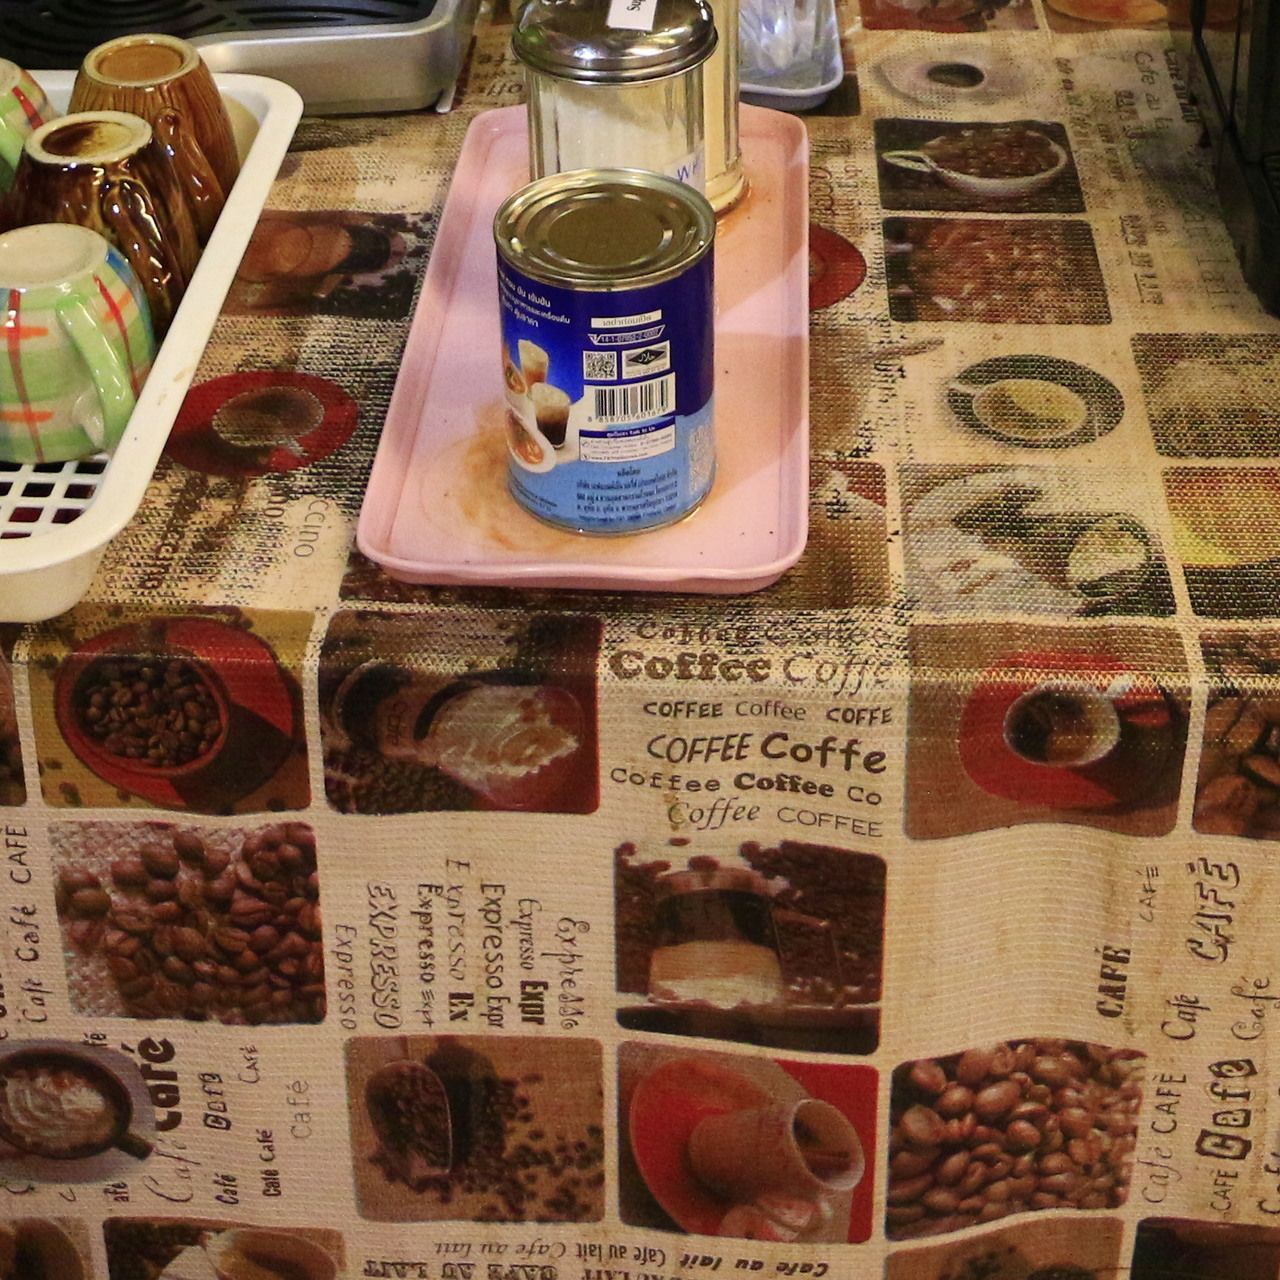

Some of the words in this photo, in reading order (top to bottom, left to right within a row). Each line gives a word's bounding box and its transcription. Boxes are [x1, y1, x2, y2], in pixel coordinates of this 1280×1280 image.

[609, 650, 770, 682] Coffee
[643, 700, 722, 718] COFFEE
[736, 700, 806, 720] Coffee
[826, 706, 892, 726] COFFE
[647, 733, 753, 764] COFFEE
[761, 732, 887, 774] Coffe
[610, 768, 720, 792] Coffee
[734, 772, 834, 798] Coffee
[848, 786, 882, 806] Co
[669, 796, 760, 830] Coffee
[777, 806, 883, 838] COFFEE
[10, 904, 40, 962] Café
[410, 884, 435, 983] Expresso
[478, 884, 506, 989] Expresso
[510, 898, 542, 970] Expresso
[368, 881, 402, 1029] EXPRESSO
[331, 924, 357, 1030] Expresso
[480, 996, 510, 1029] Expr
[519, 980, 548, 1025] Expr
[287, 1080, 312, 1139] Café
[256, 1128, 273, 1161] Café
[214, 1172, 239, 1205] Café
[434, 1243, 471, 1258] lait
[480, 1242, 508, 1254] au
[576, 1243, 602, 1260] lait
[680, 1253, 722, 1271] lait
[735, 1258, 764, 1270] au
